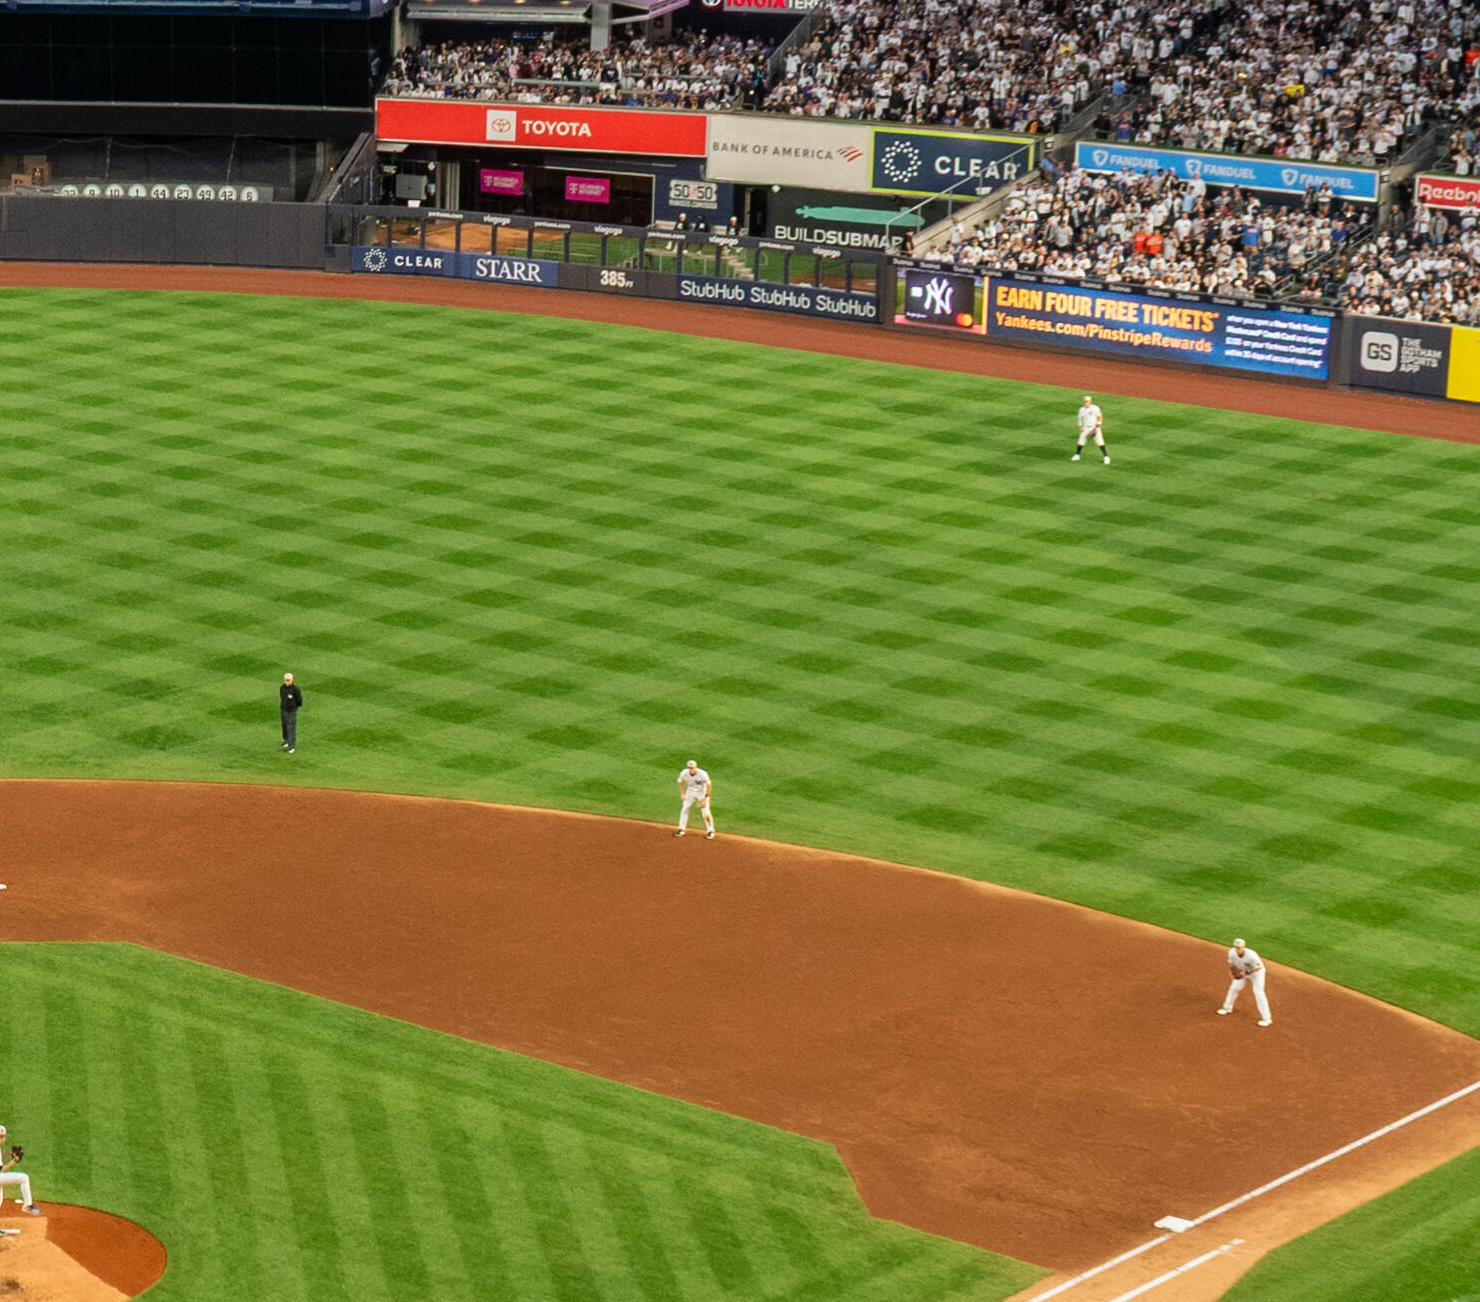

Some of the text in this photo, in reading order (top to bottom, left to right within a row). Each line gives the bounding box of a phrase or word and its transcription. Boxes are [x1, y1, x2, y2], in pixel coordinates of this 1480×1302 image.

[521, 119, 593, 138] TOYOTA
[475, 258, 542, 284] STARR
[600, 270, 626, 288] 385
[996, 285, 1139, 323] EARN FOUR FREE
[995, 311, 1213, 353] Yankees.com/PinstripeRewards
